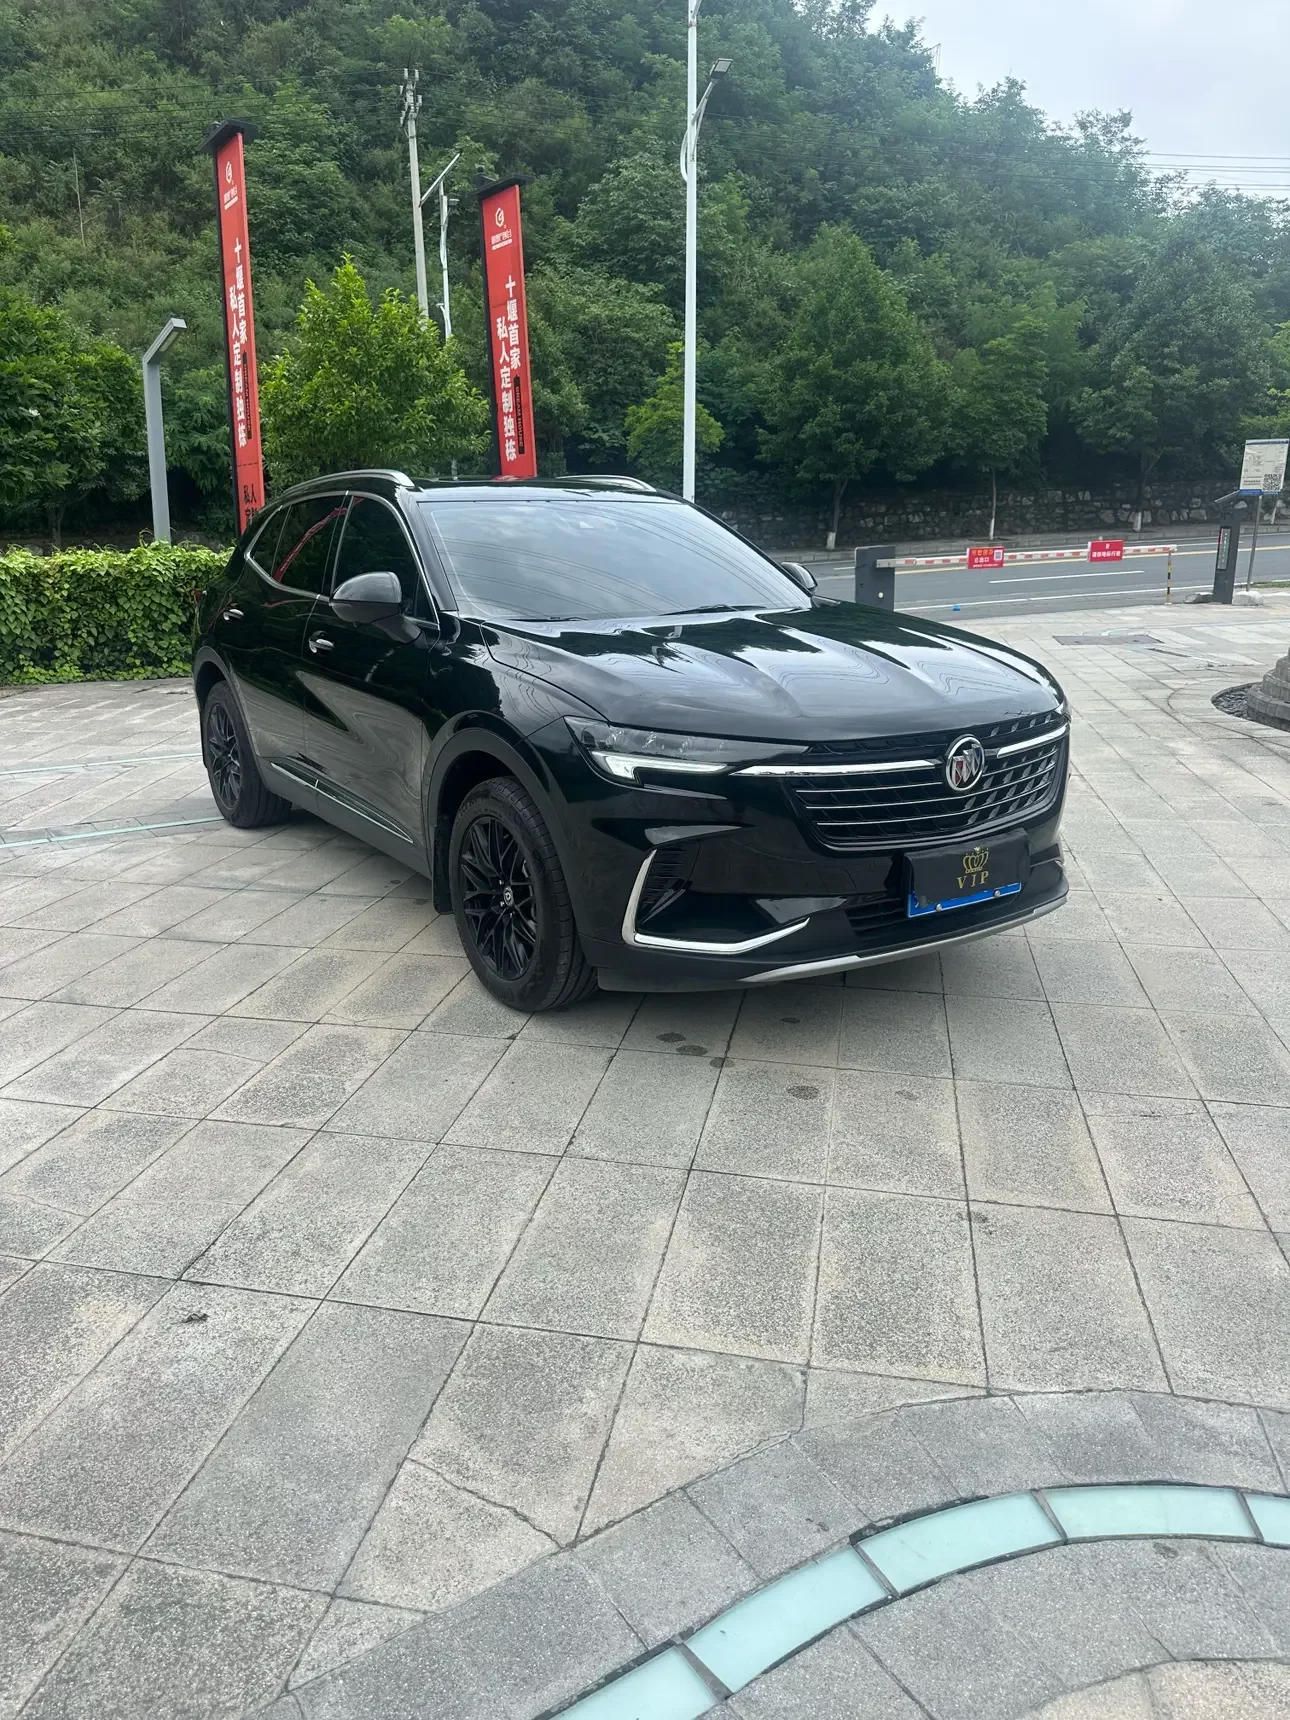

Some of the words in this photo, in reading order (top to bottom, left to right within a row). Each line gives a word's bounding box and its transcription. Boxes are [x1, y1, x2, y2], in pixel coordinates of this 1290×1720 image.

[234, 237, 247, 344] 十堰首家
[505, 275, 521, 370] 十堰首家
[229, 284, 246, 447] 私人定制独栋
[496, 316, 516, 461] 私人定制独栋
[957, 870, 989, 889] VIP
